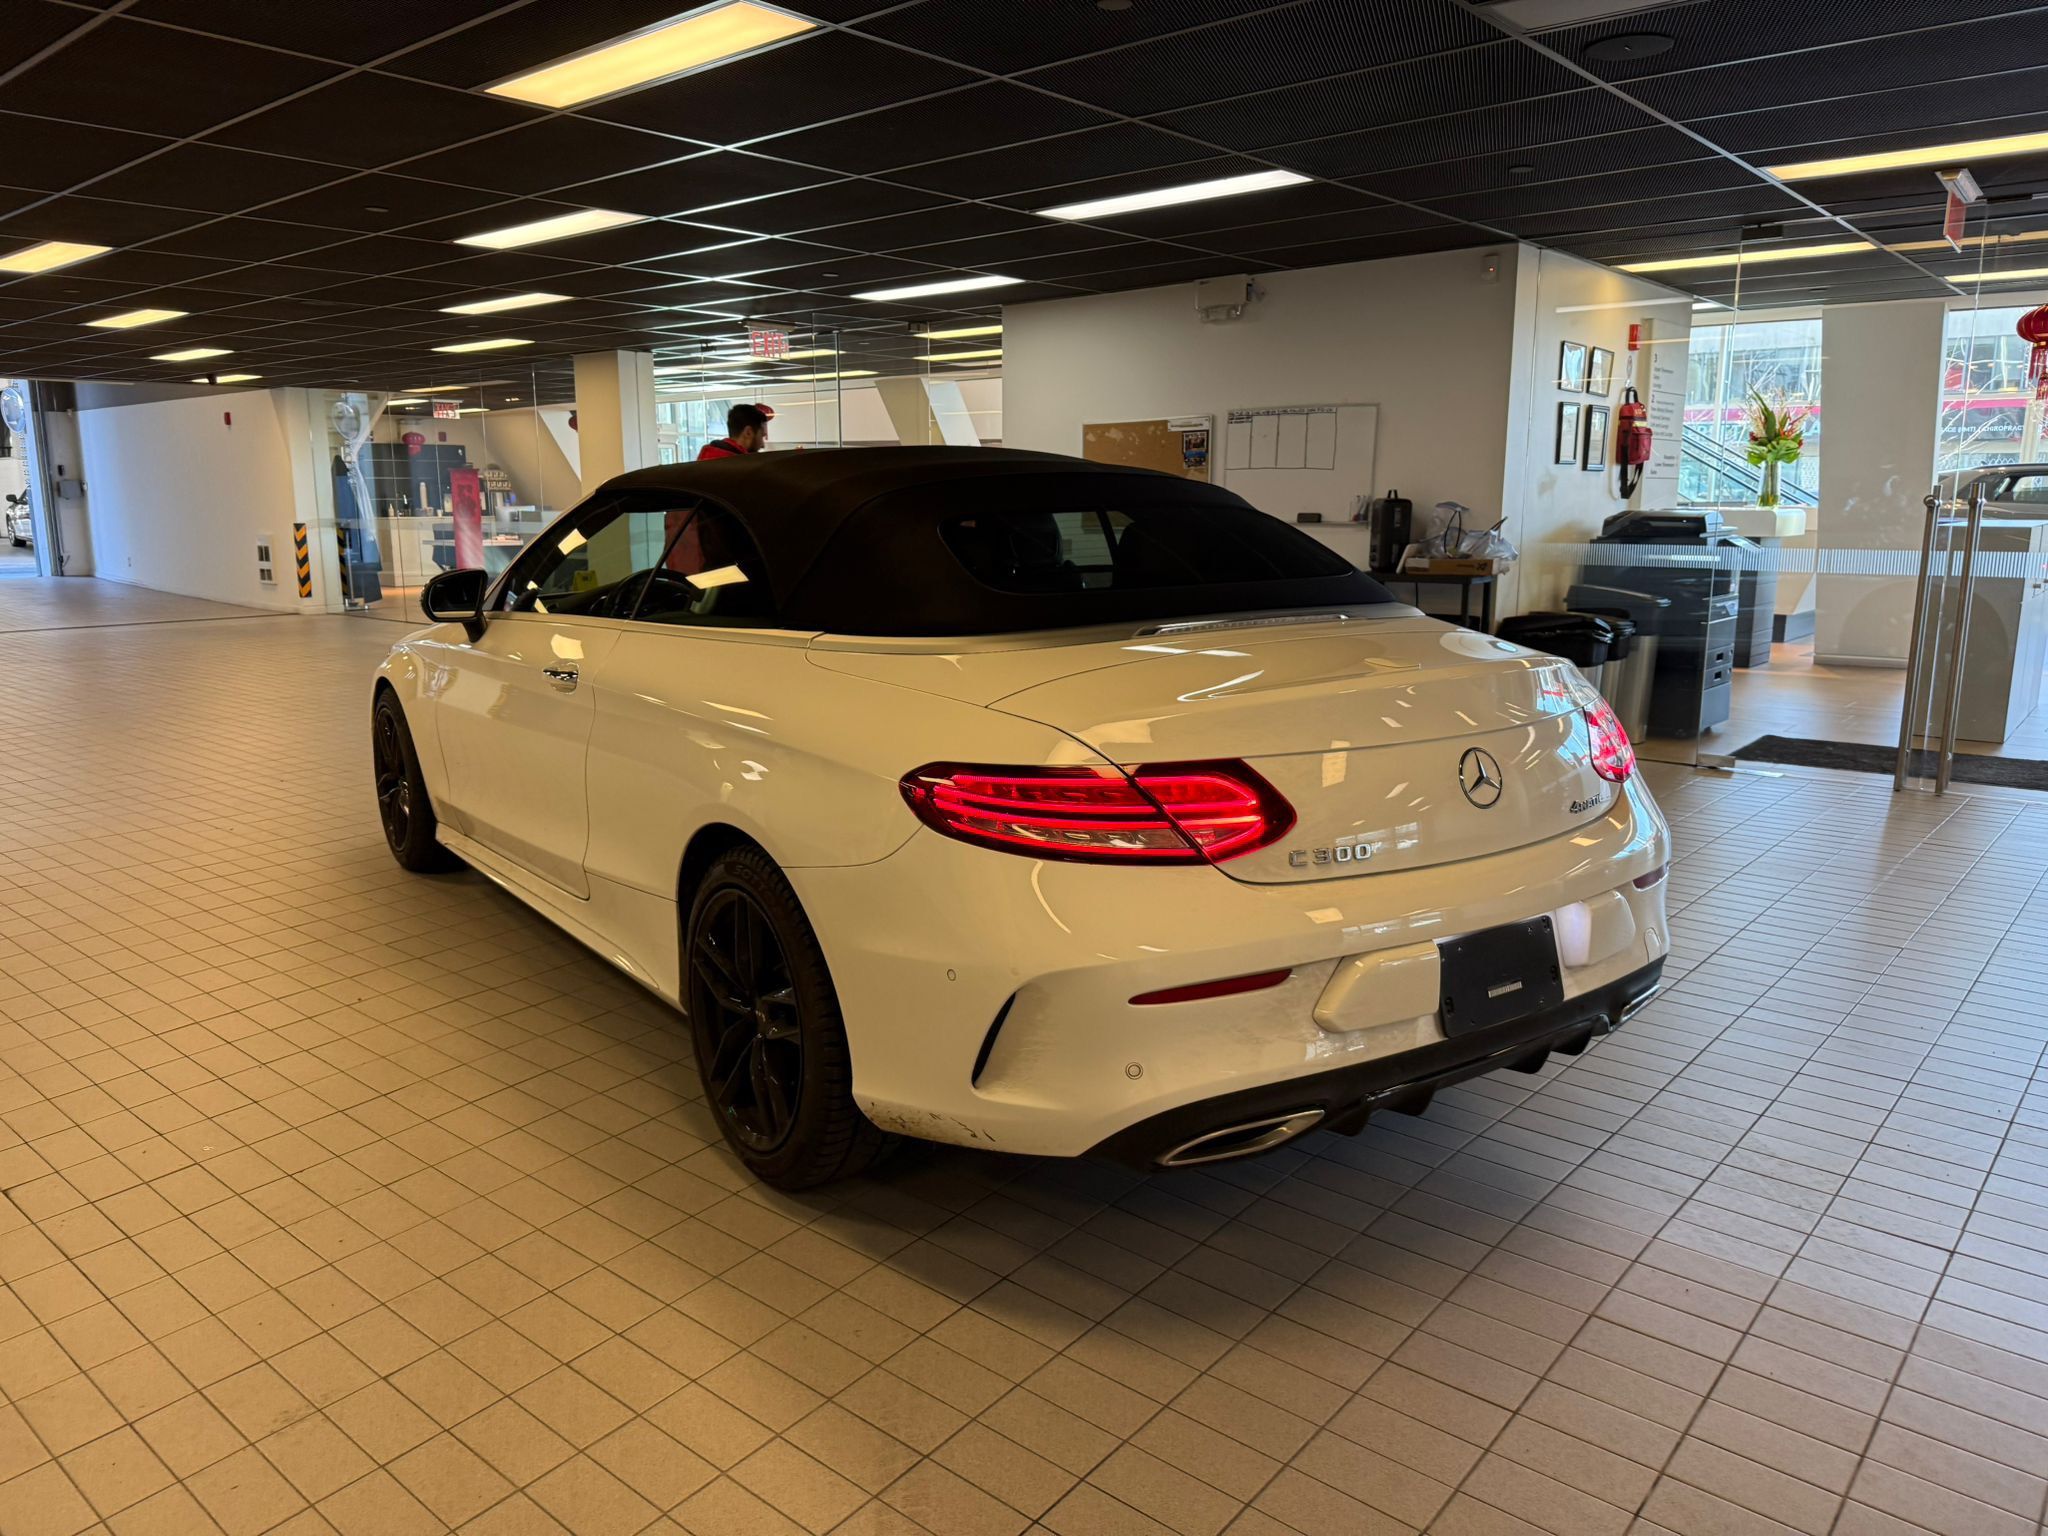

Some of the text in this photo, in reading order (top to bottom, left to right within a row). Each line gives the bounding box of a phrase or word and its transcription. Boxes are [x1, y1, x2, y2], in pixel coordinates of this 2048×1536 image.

[751, 330, 785, 358] EXIT
[1289, 843, 1372, 867] C 300
